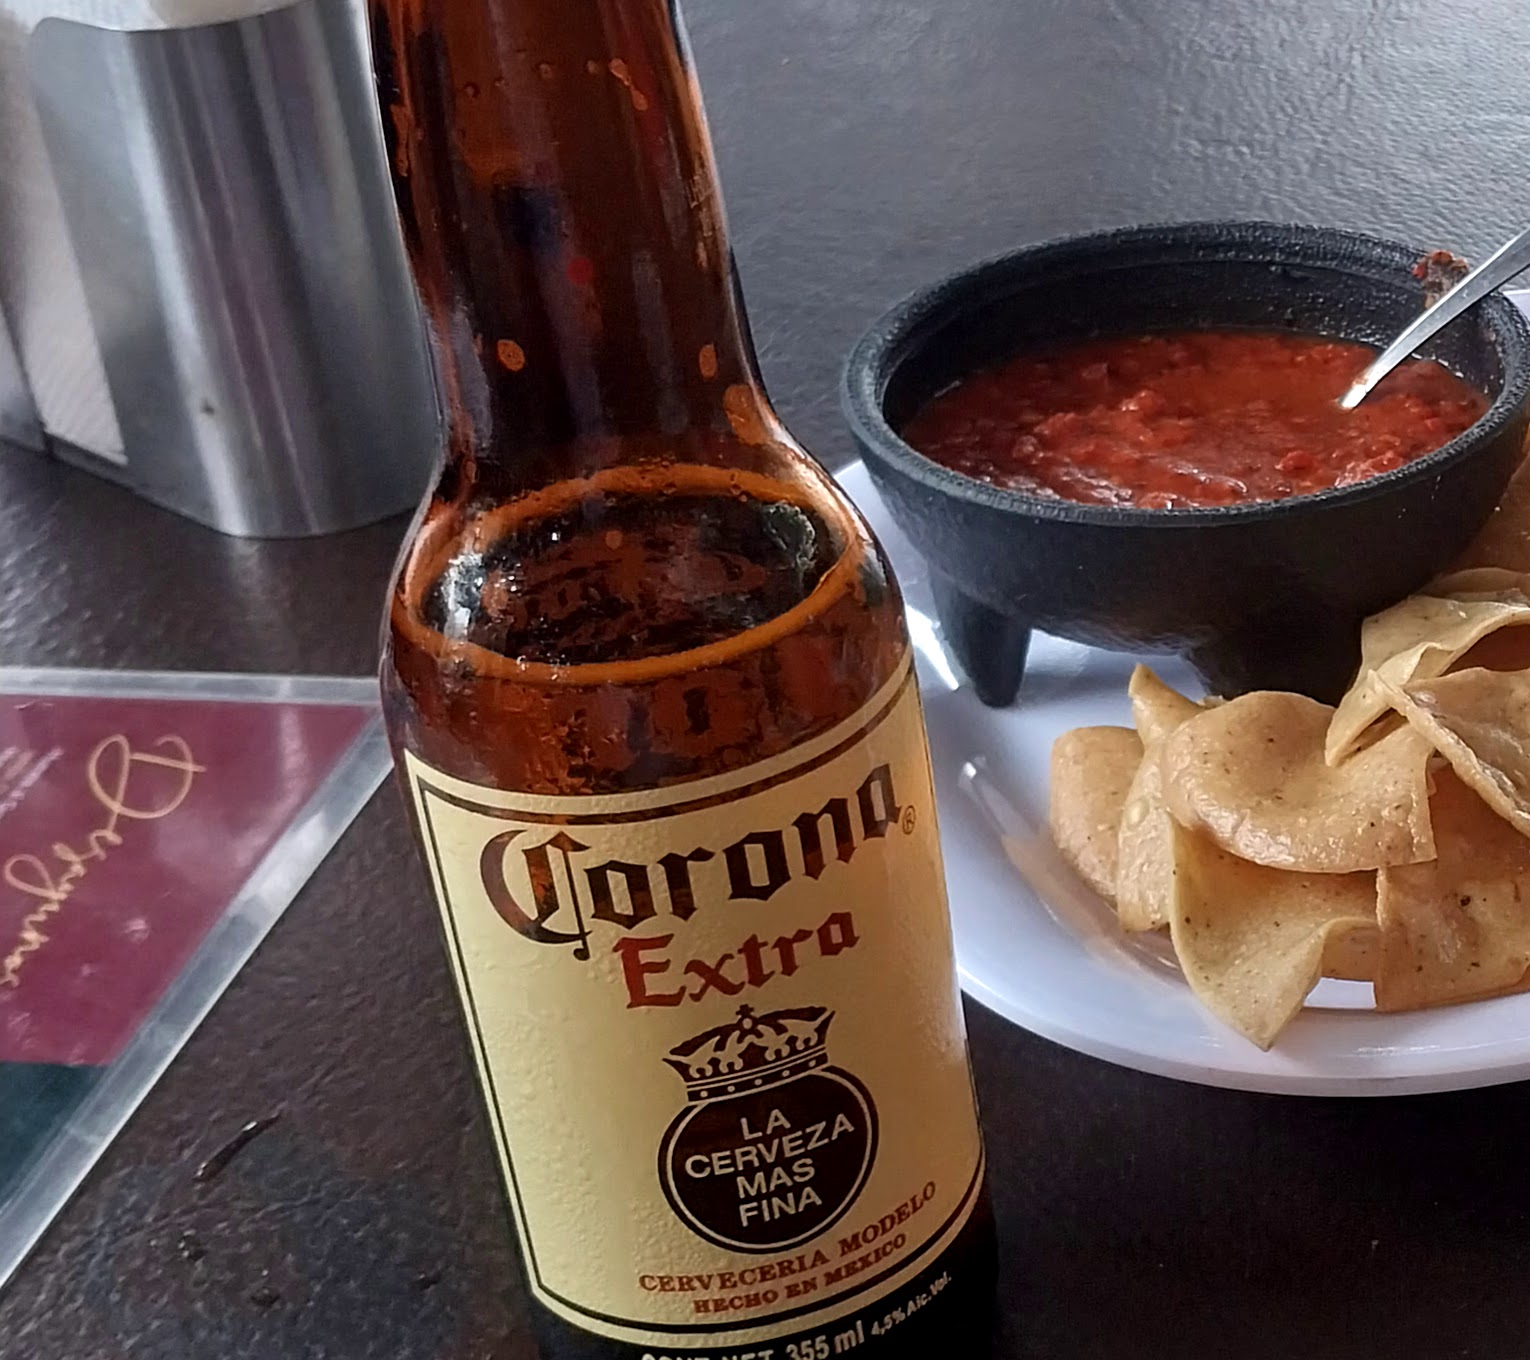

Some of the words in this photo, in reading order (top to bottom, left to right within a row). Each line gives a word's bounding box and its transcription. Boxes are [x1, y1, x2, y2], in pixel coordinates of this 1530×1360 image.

[480, 763, 902, 961] Corona
[612, 911, 860, 1010] Extra
[684, 1112, 855, 1179] CERVEZA
[740, 1108, 791, 1140] LA
[736, 1157, 816, 1200] MAS
[738, 1186, 823, 1227] FINA
[638, 1248, 831, 1293] CERVECERIA
[838, 1180, 937, 1258] MODELO
[692, 1289, 779, 1315] HECHO
[785, 1276, 819, 1299] EN
[823, 1232, 907, 1287] MEXICO
[833, 1319, 866, 1355] ml
